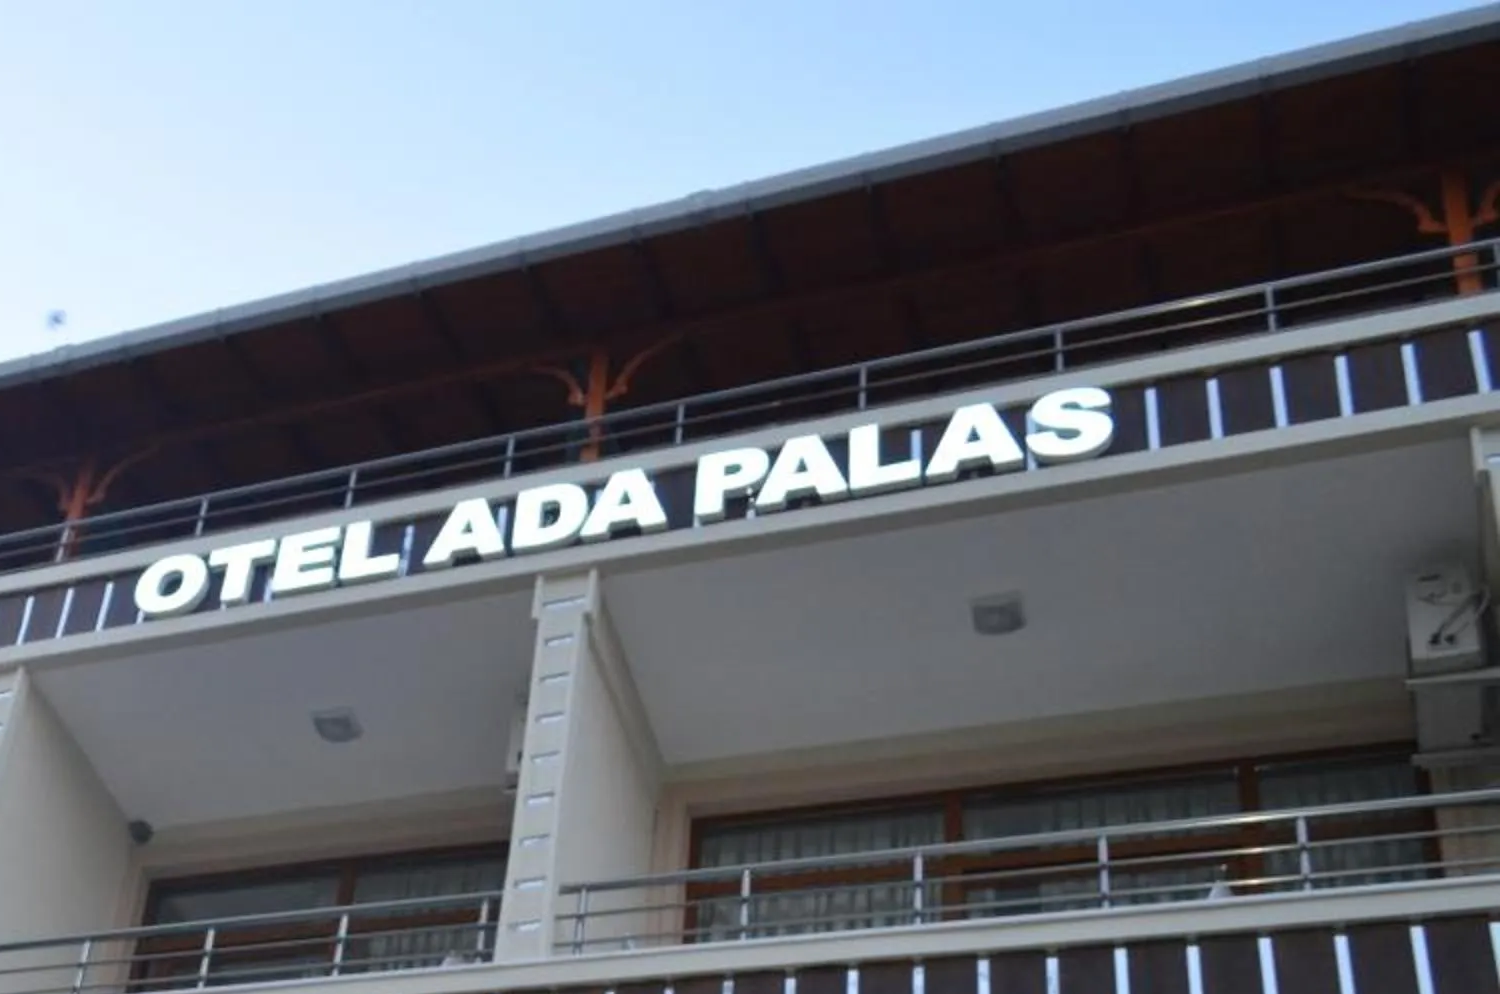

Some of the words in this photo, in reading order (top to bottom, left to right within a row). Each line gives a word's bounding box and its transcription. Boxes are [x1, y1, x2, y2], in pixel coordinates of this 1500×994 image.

[134, 520, 400, 618] OTEL
[422, 467, 668, 572] ADA
[693, 386, 1115, 524] PALAS
